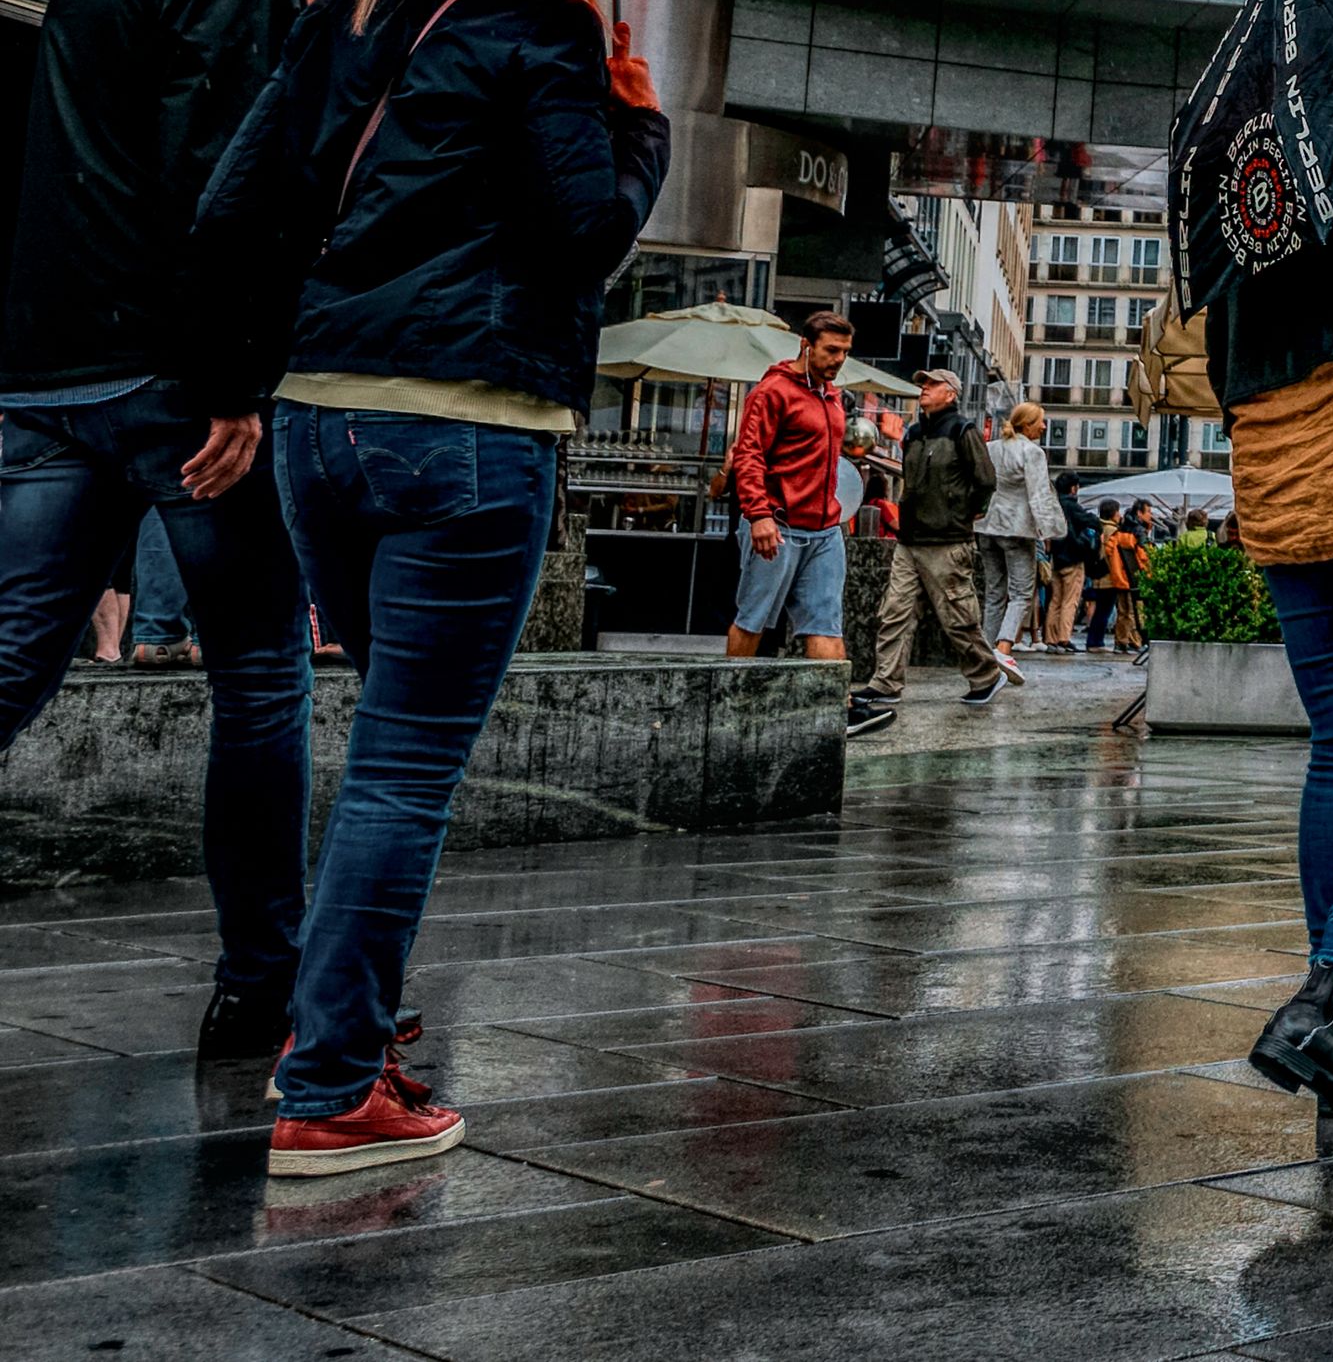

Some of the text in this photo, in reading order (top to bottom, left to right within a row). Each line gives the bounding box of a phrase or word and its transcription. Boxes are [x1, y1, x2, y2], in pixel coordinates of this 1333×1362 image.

[1227, 112, 1275, 163] BERLIN
[1231, 138, 1259, 193] BERLIN
[1263, 138, 1292, 190] BERLIN
[1218, 174, 1247, 266] BERLIN
[1252, 181, 1270, 213] B
[1181, 146, 1197, 310] BERLIN
[1231, 203, 1262, 254] BERLIN
[1267, 202, 1294, 255] BERLIN
